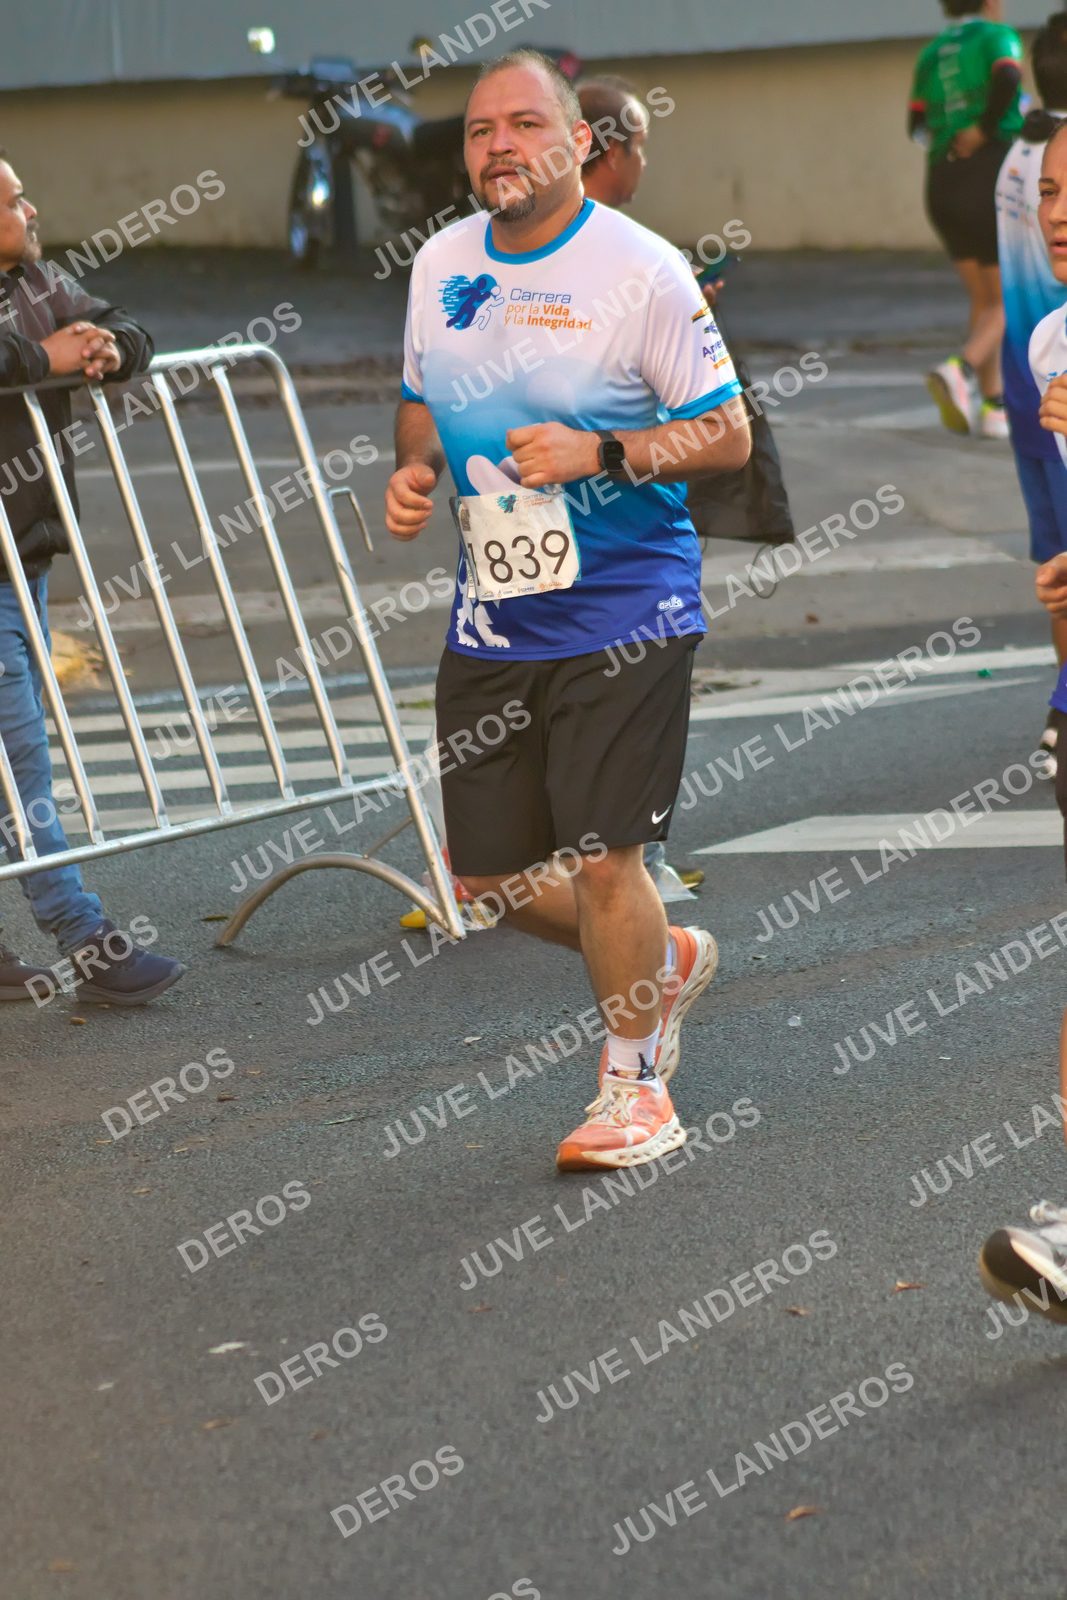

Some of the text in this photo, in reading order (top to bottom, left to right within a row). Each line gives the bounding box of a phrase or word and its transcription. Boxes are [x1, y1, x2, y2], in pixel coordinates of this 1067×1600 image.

[510, 288, 572, 304] Carrera
[506, 303, 570, 317] por la Vida
[513, 314, 524, 325] la
